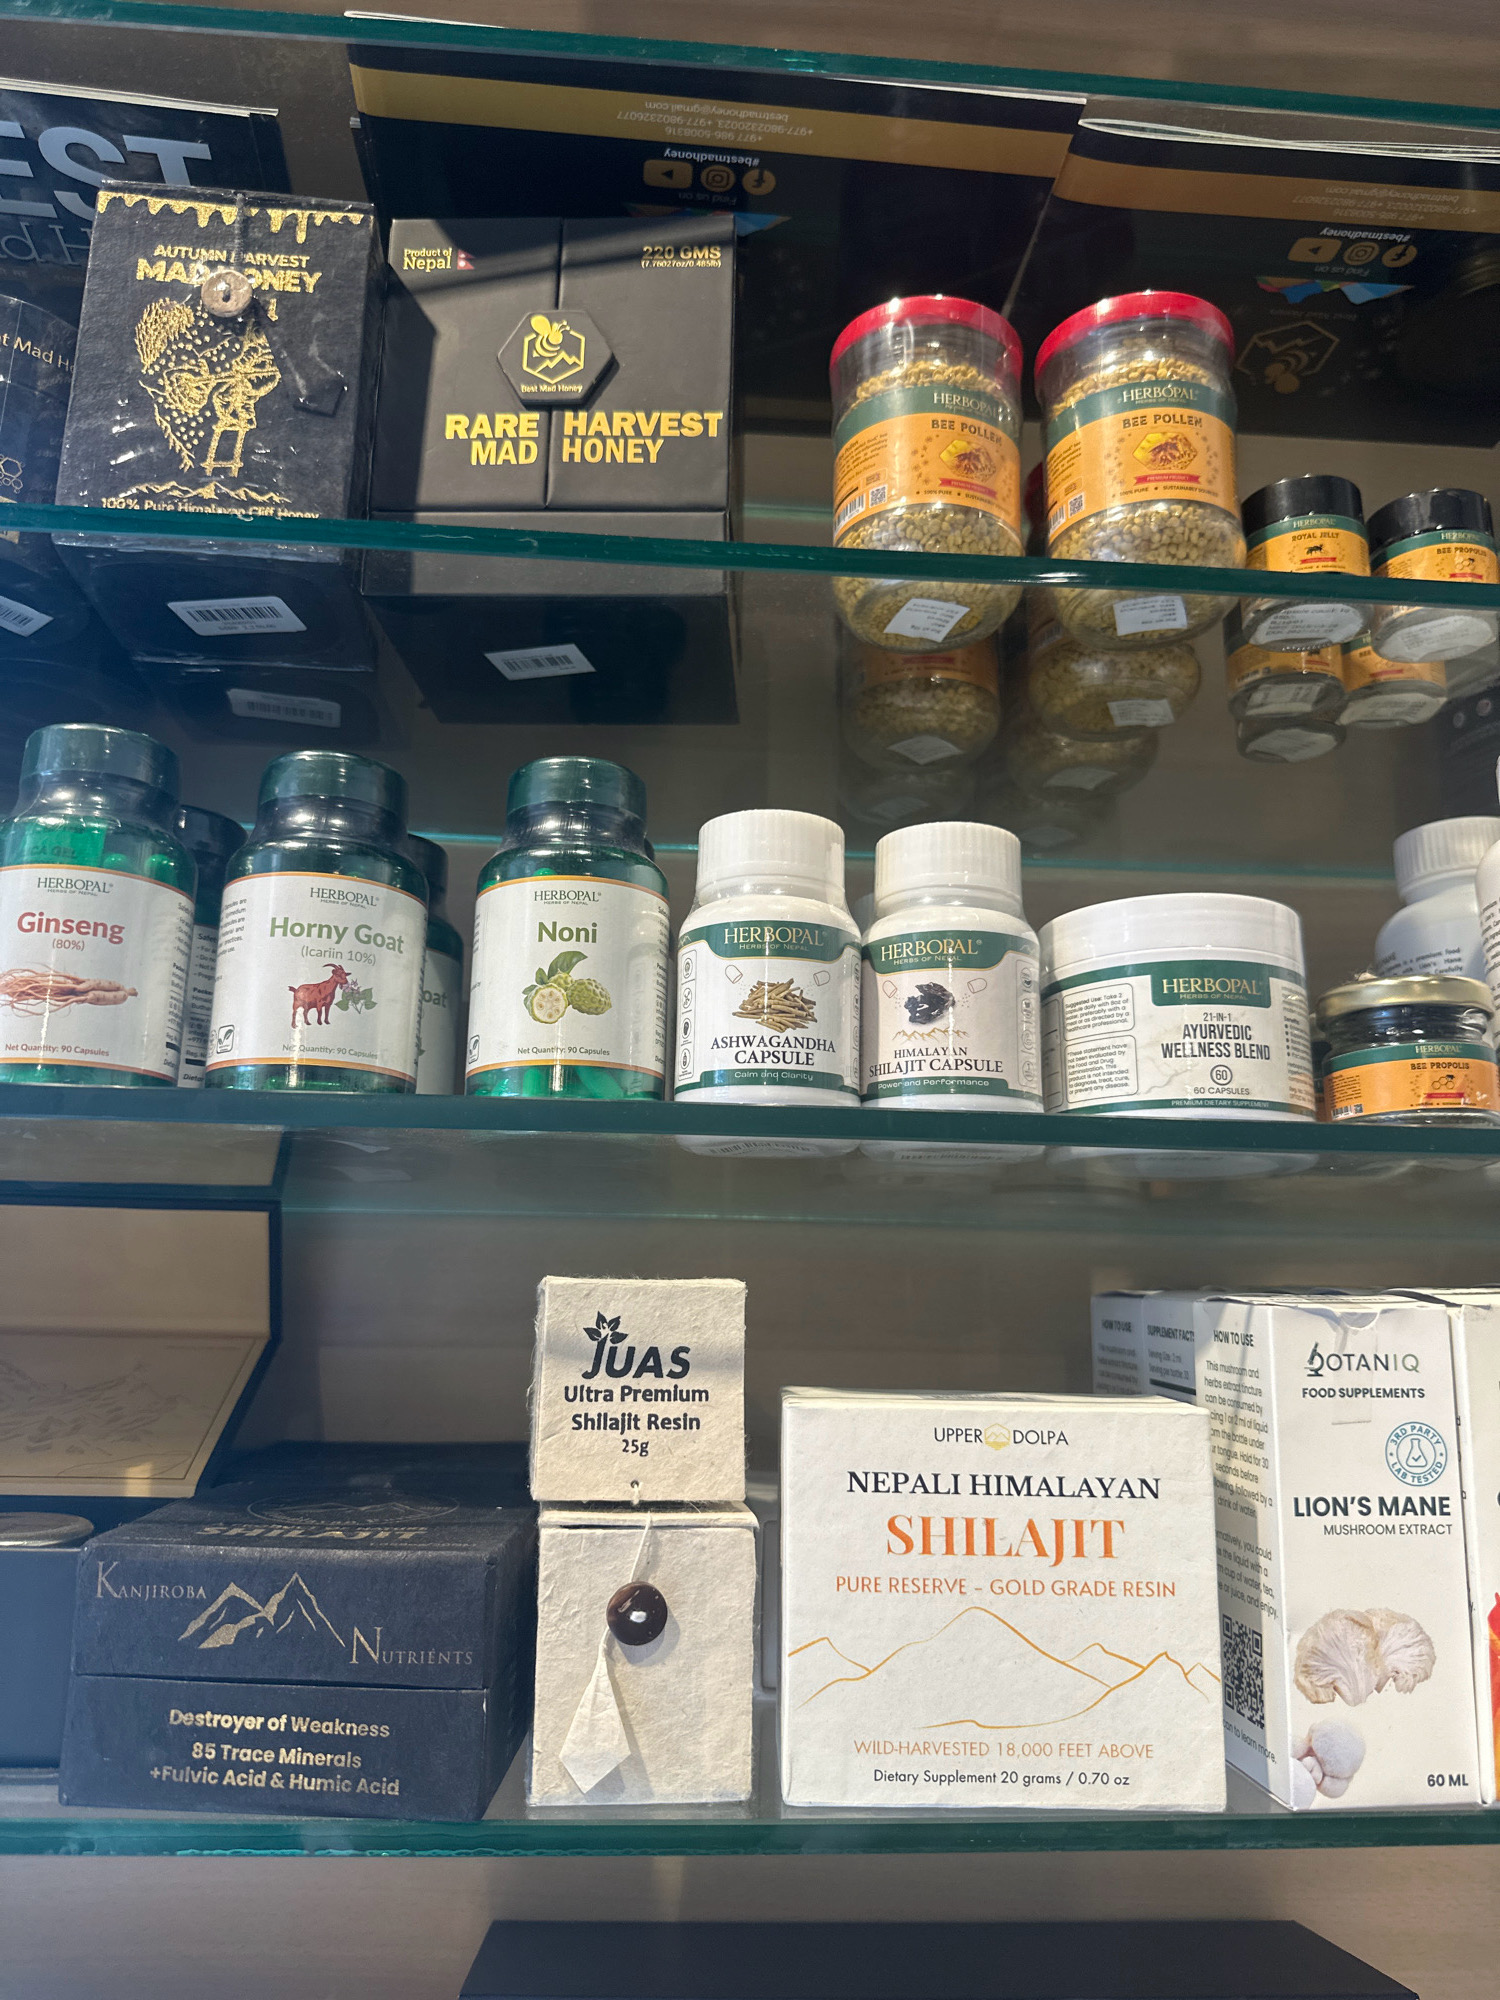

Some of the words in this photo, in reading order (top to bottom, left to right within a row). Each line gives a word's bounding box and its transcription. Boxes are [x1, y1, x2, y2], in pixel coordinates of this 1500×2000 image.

[663, 147, 760, 167] #bestmadhoney
[1320, 227, 1411, 243] #bestmadhoney
[154, 245, 227, 263] AUTUMN
[404, 247, 440, 258] Product
[442, 246, 453, 257] of
[642, 246, 675, 260] 220
[680, 246, 721, 260] GMS
[403, 255, 452, 273] Nepal
[13, 336, 54, 364] Mad
[521, 384, 538, 394] Best
[540, 384, 557, 393] Mad
[558, 384, 583, 395] Honey
[445, 413, 540, 440] RARE
[564, 411, 724, 438] HARVEST
[931, 419, 955, 431] BEE
[1122, 415, 1148, 429] BEE
[1153, 413, 1203, 428] POLLEN
[471, 440, 539, 465] MAD
[562, 438, 664, 464] HONEY
[102, 498, 139, 510] 100%
[144, 500, 174, 512] Pure
[1291, 533, 1318, 542] ROYAL
[17, 911, 125, 945] Ginseng
[270, 917, 348, 944] Horny
[354, 924, 405, 954] Goat
[538, 921, 598, 943] Noni
[52, 938, 85, 951] (80%)
[301, 945, 343, 960] (Icariin
[347, 949, 376, 966] 10%)
[1203, 1012, 1232, 1022] 21-IN-1
[1182, 1023, 1253, 1041] AYURVEDIC
[5, 1043, 19, 1052] Net
[20, 1043, 59, 1054] Quantity:
[61, 1045, 72, 1053] 90
[74, 1046, 110, 1057] Capsules
[298, 1044, 335, 1055] Quantity:
[336, 1047, 347, 1055] 90
[348, 1048, 378, 1060] Capsules
[517, 1047, 530, 1055] Net
[567, 1046, 578, 1055] 90
[579, 1047, 610, 1056] Capsules
[710, 1035, 836, 1053] ASHWAGANDHA
[894, 1047, 968, 1058] HIMALAYAN
[1161, 1042, 1231, 1059] WELLNESS
[1234, 1042, 1271, 1060] BLEND
[734, 1050, 815, 1066] CAPSULE
[1410, 1062, 1427, 1070] BEE
[1430, 1062, 1470, 1070] PROPOLIS
[781, 1071, 814, 1081] Clarity
[869, 1059, 926, 1078] SHILAJIT
[929, 1058, 1003, 1073] CAPSULE
[1215, 1069, 1228, 1081] 60
[878, 1080, 901, 1089] Power
[904, 1079, 921, 1087] and
[923, 1078, 990, 1086] Performance
[1193, 1087, 1205, 1095] 60
[1207, 1087, 1250, 1096] CAPSULES
[1147, 1324, 1178, 1340] SUPPLEMENT
[1213, 1330, 1229, 1344] HOW
[1230, 1332, 1240, 1345] TO
[1240, 1333, 1254, 1347] USE
[581, 1332, 691, 1380] JUAS
[564, 1384, 614, 1402] Ultra
[620, 1384, 709, 1402] Premium
[1302, 1387, 1336, 1398] FOOD
[1338, 1387, 1425, 1399] SUPPLEMENTS
[571, 1412, 640, 1435] Shilajit
[647, 1412, 701, 1431] Resin
[933, 1426, 983, 1445] UPPER
[1013, 1429, 1069, 1446] DOLPA
[1390, 1427, 1408, 1446] 3RD
[1410, 1424, 1442, 1445] PARTY
[621, 1439, 650, 1457] 25g
[1391, 1461, 1408, 1480] LAB
[1410, 1461, 1443, 1484] TESTED
[847, 1471, 960, 1496] NEPALI
[969, 1473, 1161, 1500] HIMALAYAN
[1293, 1496, 1372, 1517] LION'S
[1378, 1495, 1452, 1517] MANE
[1323, 1524, 1396, 1536] MUSHROOM
[1399, 1523, 1453, 1536] EXTRACT
[887, 1514, 1126, 1567] SHILAJIT
[95, 1560, 207, 1601] KANJIROBA
[836, 1575, 882, 1593] PURE
[888, 1576, 967, 1595] RESERVE
[989, 1579, 1045, 1596] GOLD
[1051, 1580, 1118, 1597] GRADE
[1123, 1581, 1176, 1598] RESIN
[349, 1627, 473, 1665] NUTRIENTS
[169, 1708, 264, 1734] Destroyer
[267, 1714, 288, 1732] of
[290, 1715, 390, 1738] Weakness
[191, 1742, 216, 1760] 85
[220, 1744, 275, 1763] Trace
[278, 1747, 362, 1768] Minerals
[854, 1740, 989, 1757] WILD-HARVESTED
[997, 1741, 1053, 1759] 18,000
[1058, 1742, 1092, 1758] FEET
[1098, 1743, 1155, 1759] ABOVE
[150, 1765, 219, 1784] +Fulvic
[222, 1769, 266, 1788] Acid
[269, 1772, 285, 1788] &
[289, 1773, 352, 1792] Humic
[356, 1777, 401, 1796] Acid
[873, 1769, 919, 1787] Dietary
[923, 1769, 997, 1788] Supplement
[1000, 1771, 1019, 1784] 20
[1022, 1774, 1061, 1788] grams
[1078, 1771, 1110, 1786] 0.70
[1113, 1775, 1130, 1786] oz
[1427, 1774, 1445, 1787] 60
[1448, 1774, 1469, 1787] ML
